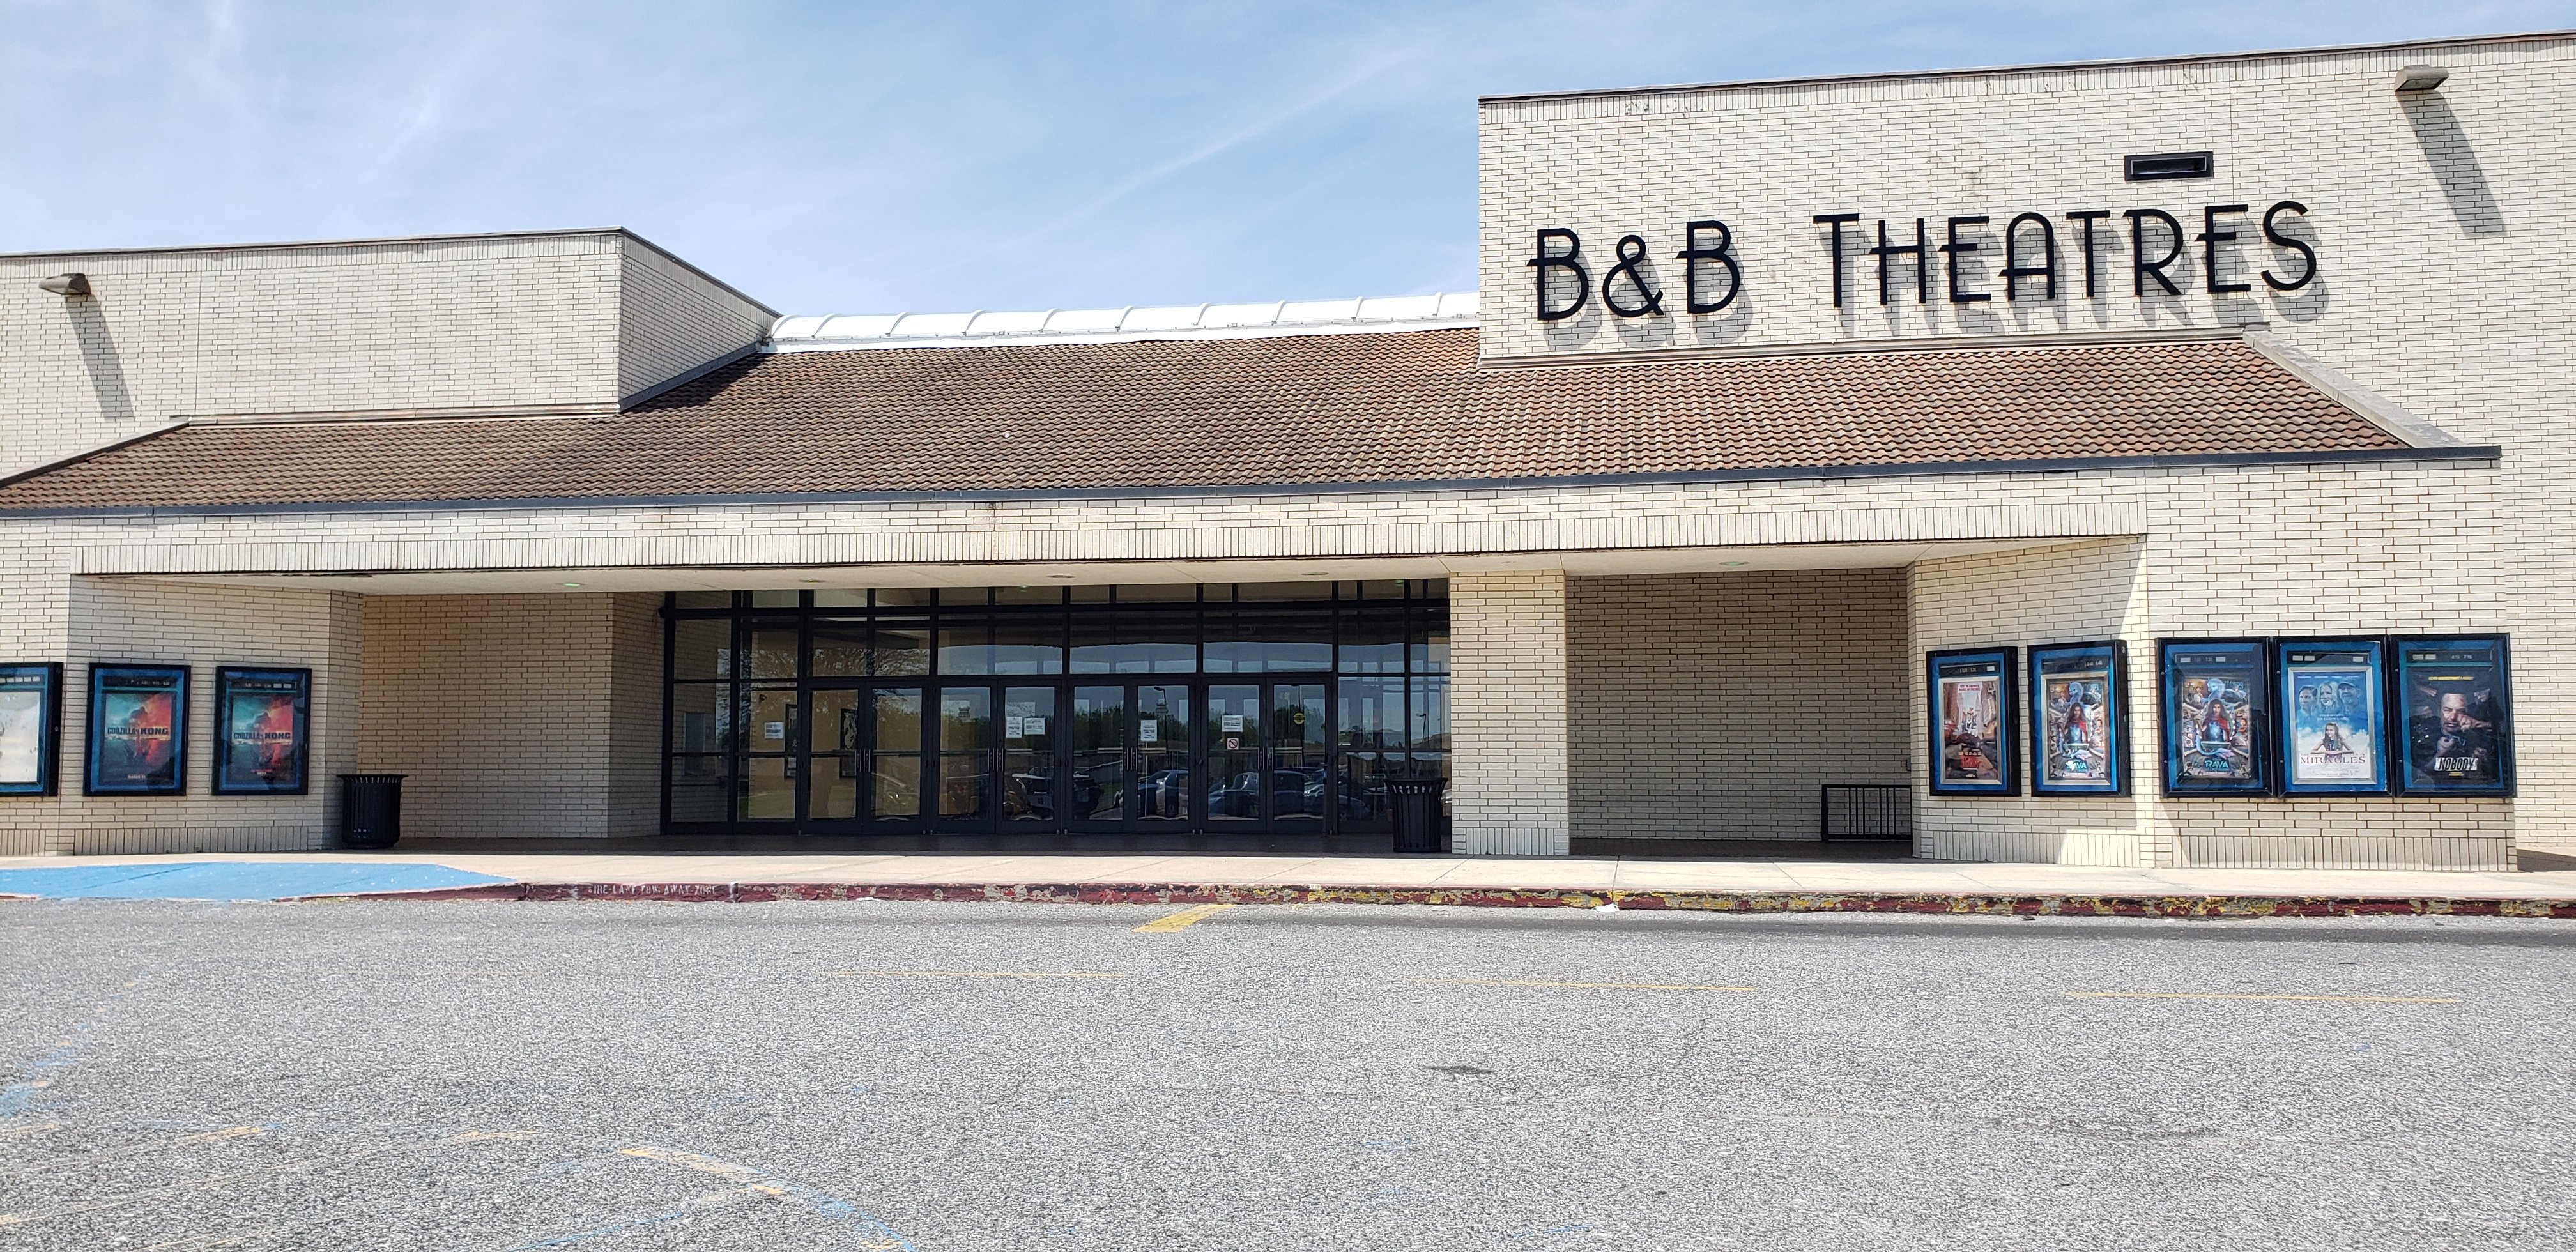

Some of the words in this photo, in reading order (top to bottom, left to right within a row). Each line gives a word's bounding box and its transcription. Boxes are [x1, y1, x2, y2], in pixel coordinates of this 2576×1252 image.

[1526, 220, 1741, 321] B&B
[1813, 200, 2318, 308] THEATRES
[2204, 760, 2229, 768] RAYA
[2438, 758, 2474, 770] NOBODY
